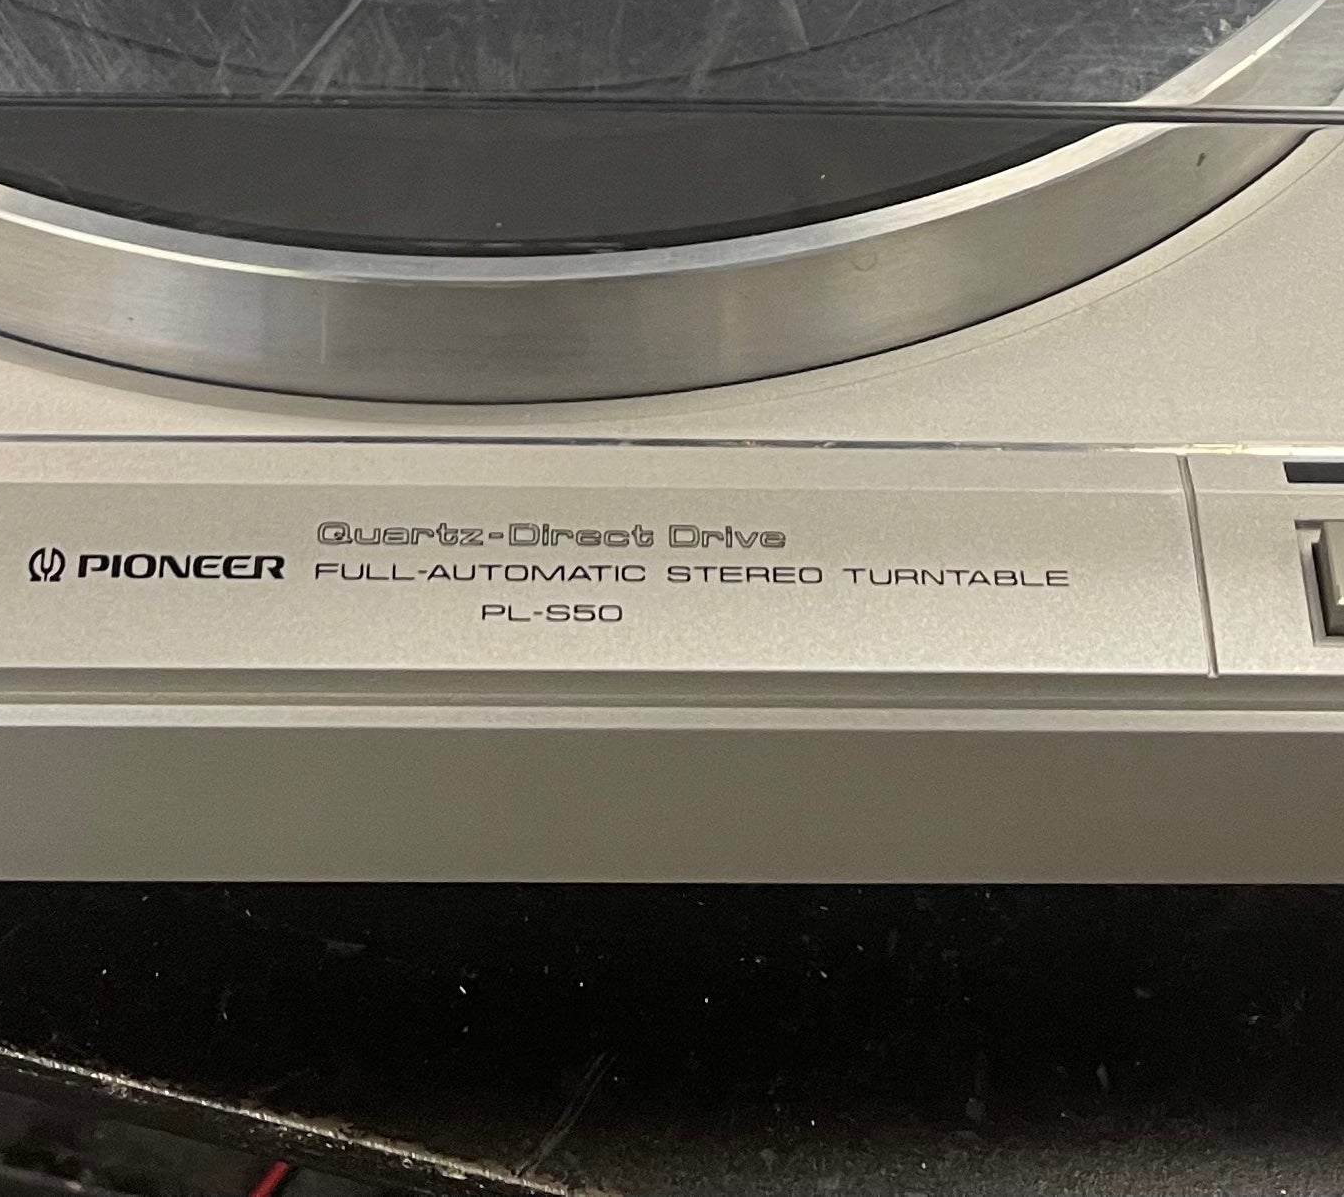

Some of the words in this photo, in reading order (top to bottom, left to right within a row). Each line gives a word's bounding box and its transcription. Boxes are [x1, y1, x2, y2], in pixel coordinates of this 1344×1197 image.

[317, 521, 655, 548] Quartz-Direct
[668, 524, 787, 549] Drive
[77, 554, 286, 580] PIONEER
[315, 563, 646, 583] FULL-AUTOMATIC
[667, 566, 823, 584] STEREO
[843, 567, 1071, 587] TURNTABLE
[481, 603, 623, 623] PL-S50
